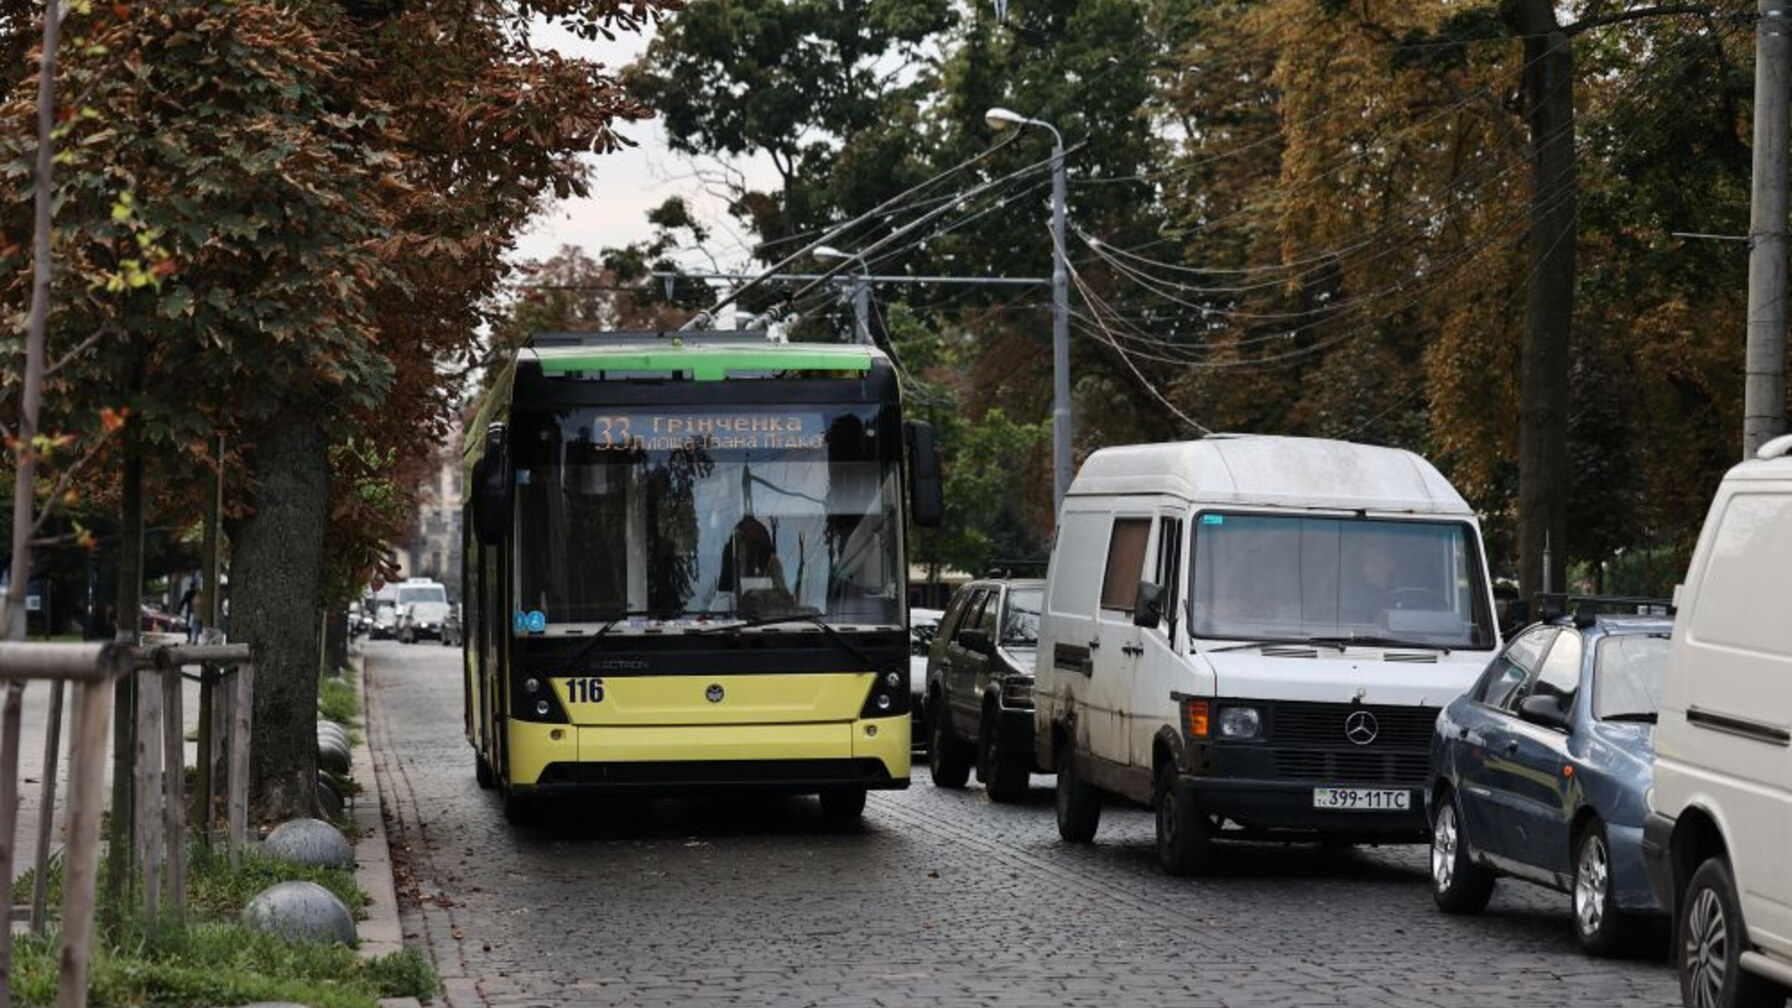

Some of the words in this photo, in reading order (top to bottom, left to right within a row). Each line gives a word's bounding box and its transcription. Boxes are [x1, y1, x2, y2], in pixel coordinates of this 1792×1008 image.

[593, 416, 631, 451] 33
[652, 417, 803, 433] Грінченка
[633, 434, 695, 451] Площа
[702, 434, 757, 450] Івана
[566, 678, 604, 704] 116
[1328, 789, 1406, 808] 399-11TC
